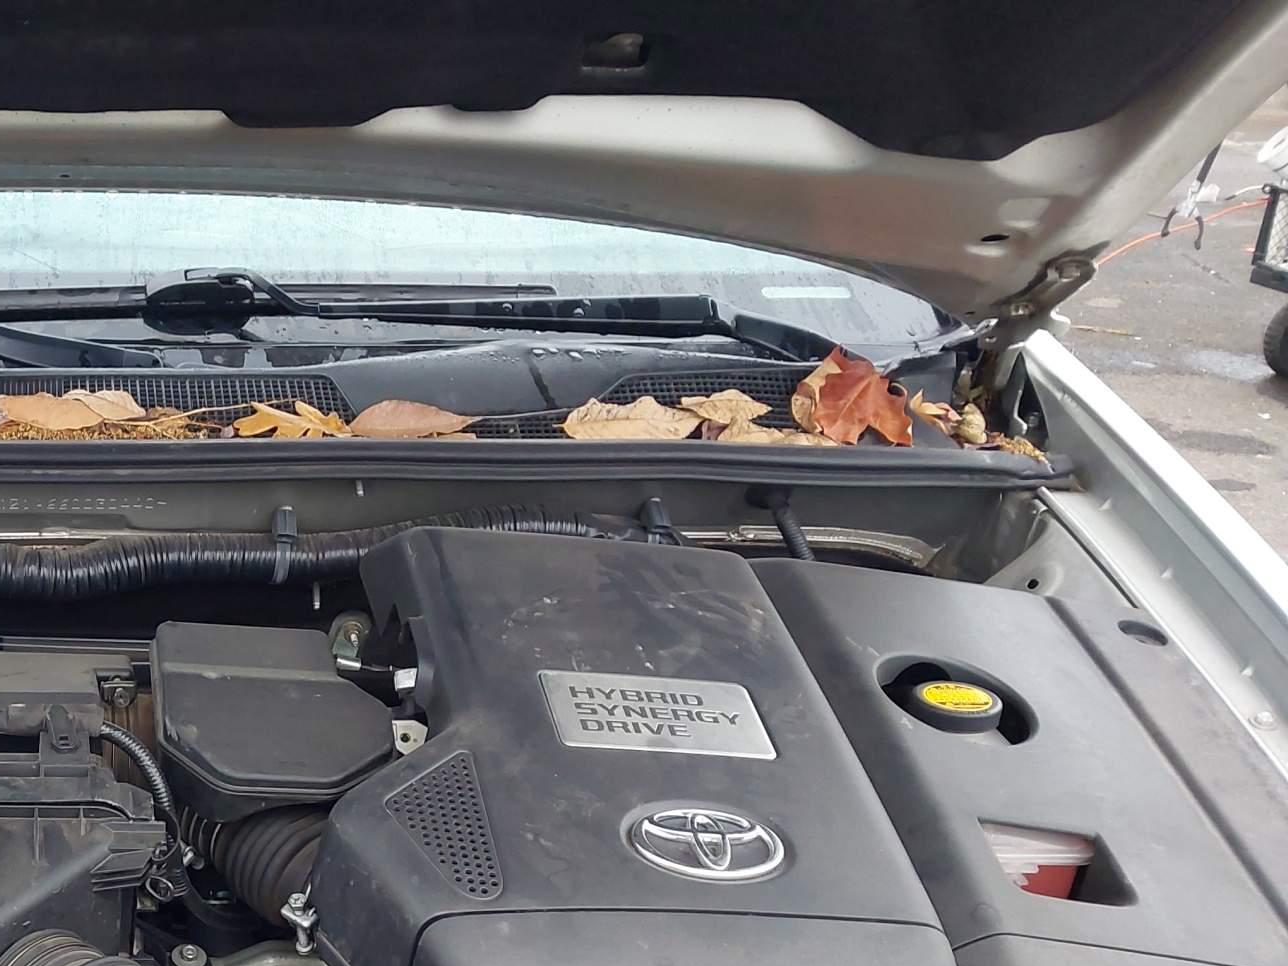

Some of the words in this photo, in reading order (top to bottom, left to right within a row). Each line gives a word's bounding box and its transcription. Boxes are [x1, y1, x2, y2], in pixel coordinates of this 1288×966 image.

[569, 686, 704, 706] HYBRID
[574, 703, 740, 725] SYNERGY
[579, 719, 691, 737] DRIVE
